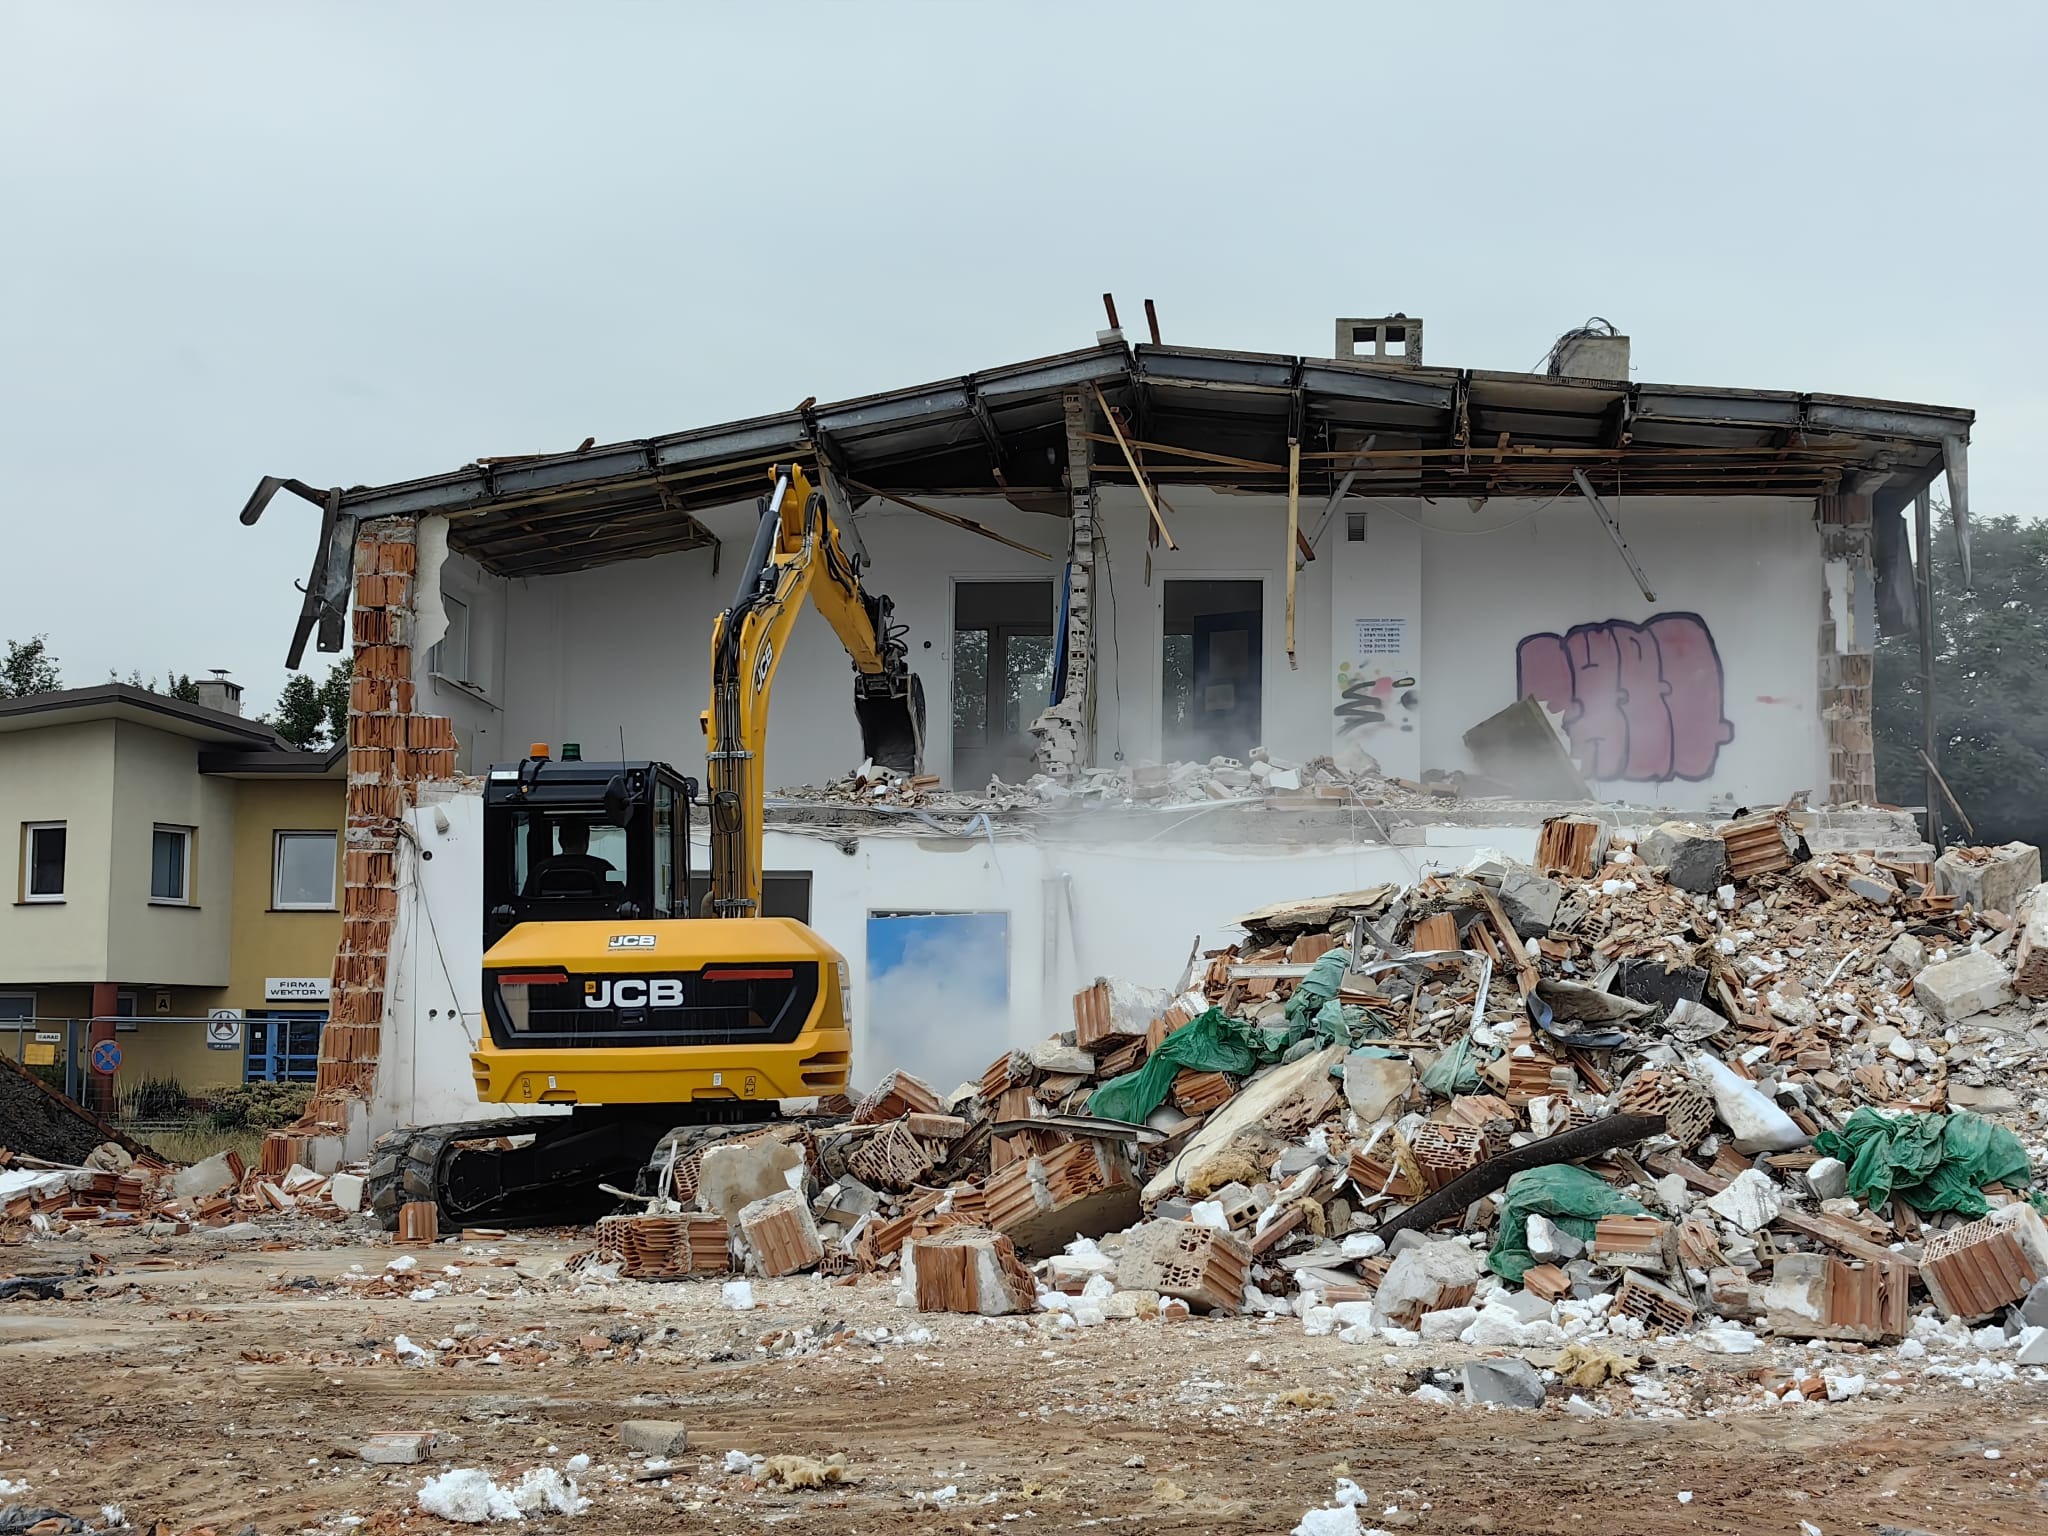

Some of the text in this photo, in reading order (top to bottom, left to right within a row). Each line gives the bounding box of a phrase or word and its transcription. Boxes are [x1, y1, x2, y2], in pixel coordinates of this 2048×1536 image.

[757, 641, 773, 692] JCB
[610, 935, 655, 946] JCB
[158, 998, 168, 1009] A
[585, 979, 684, 1008] JCB
